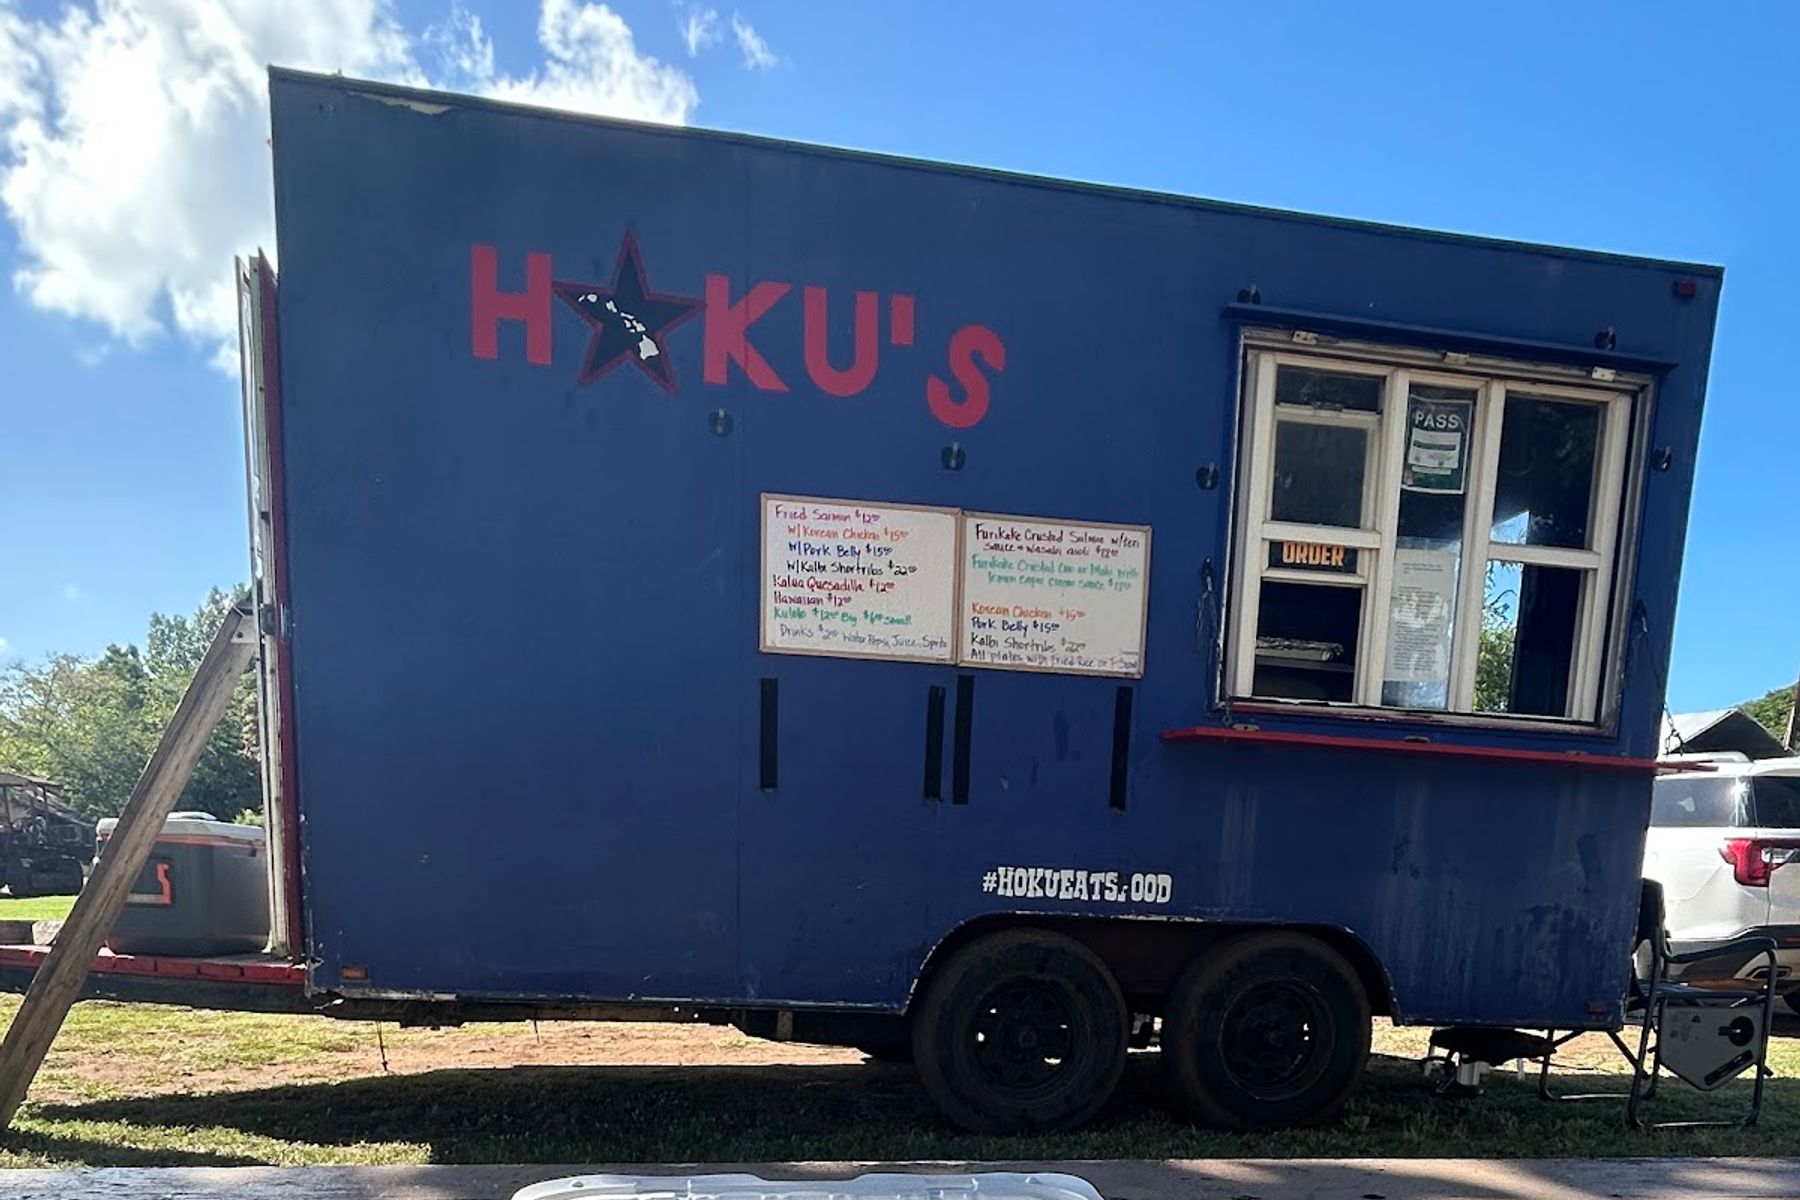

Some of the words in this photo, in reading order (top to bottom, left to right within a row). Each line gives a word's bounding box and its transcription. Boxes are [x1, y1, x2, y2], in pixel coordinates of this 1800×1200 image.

[1414, 410, 1461, 429] PASS
[775, 504, 808, 520] Fried
[843, 527, 880, 540] Chicken
[976, 522, 1021, 541] Furikake
[1024, 528, 1064, 543] Crusted
[1069, 530, 1105, 545] Salmon
[836, 544, 861, 564] Belly
[1282, 541, 1345, 567] ORDER
[773, 574, 804, 588] Kalua
[807, 576, 864, 592] Quesadilla
[774, 590, 824, 605] Hawaiian
[972, 602, 1009, 616] Korean
[1013, 605, 1052, 618] Chicken
[780, 623, 814, 638] Drinks
[971, 616, 997, 630] Pork
[1002, 619, 1028, 638] Belly
[971, 648, 986, 661] All
